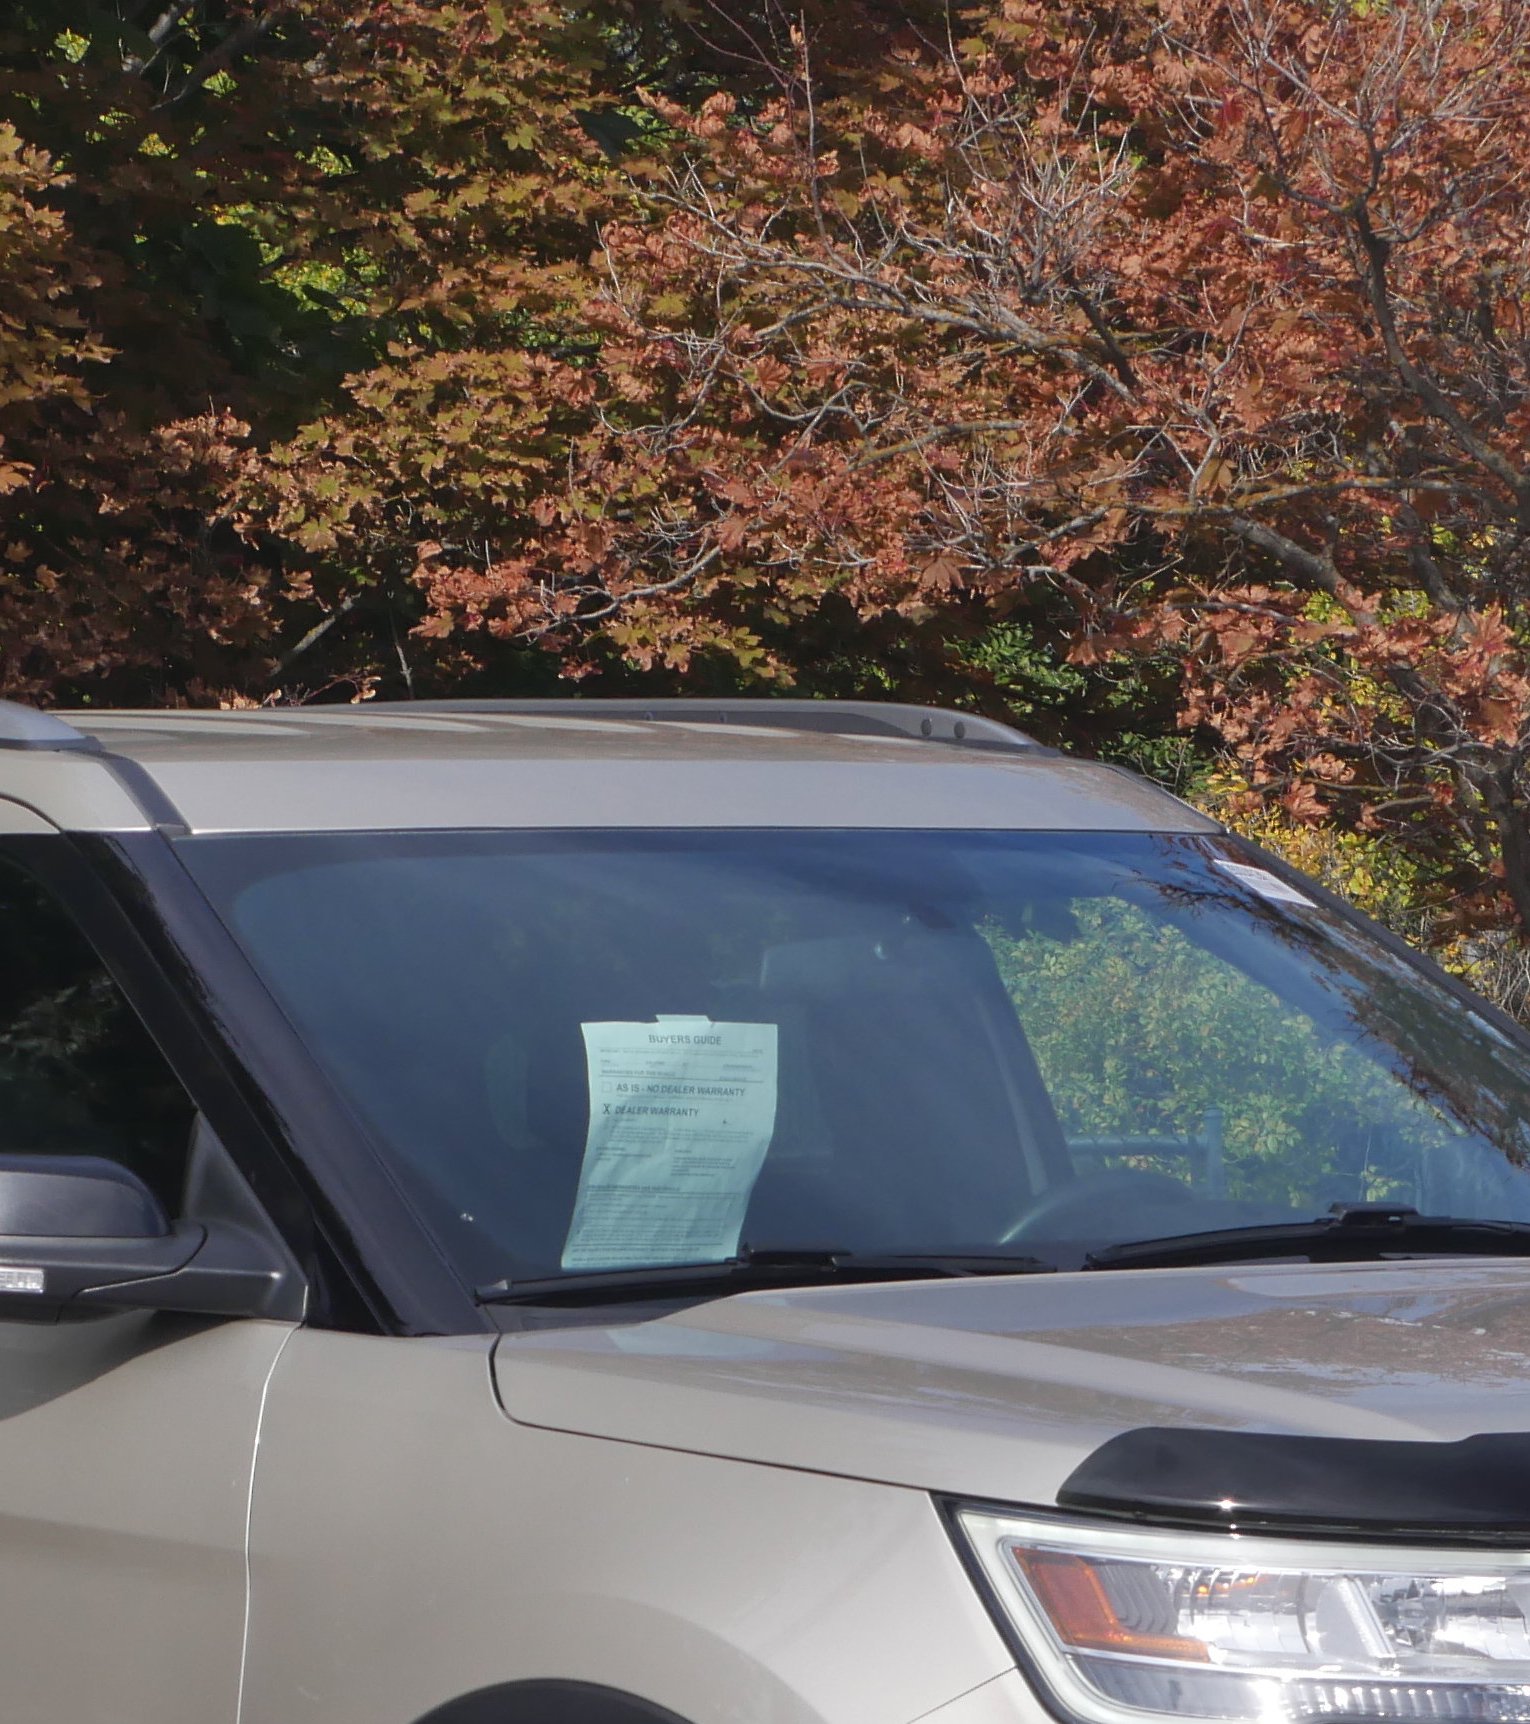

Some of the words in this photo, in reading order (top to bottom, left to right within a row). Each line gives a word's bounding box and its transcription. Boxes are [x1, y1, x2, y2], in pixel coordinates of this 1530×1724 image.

[648, 1034, 691, 1044] BUYERS
[693, 1035, 722, 1045] GUIDE
[616, 1083, 628, 1092] AS
[646, 1084, 661, 1093] NO
[661, 1085, 695, 1095] DEALER
[697, 1086, 745, 1097] WARRANTY
[615, 1105, 650, 1115] DEALER
[650, 1106, 699, 1117] WARRANTY
